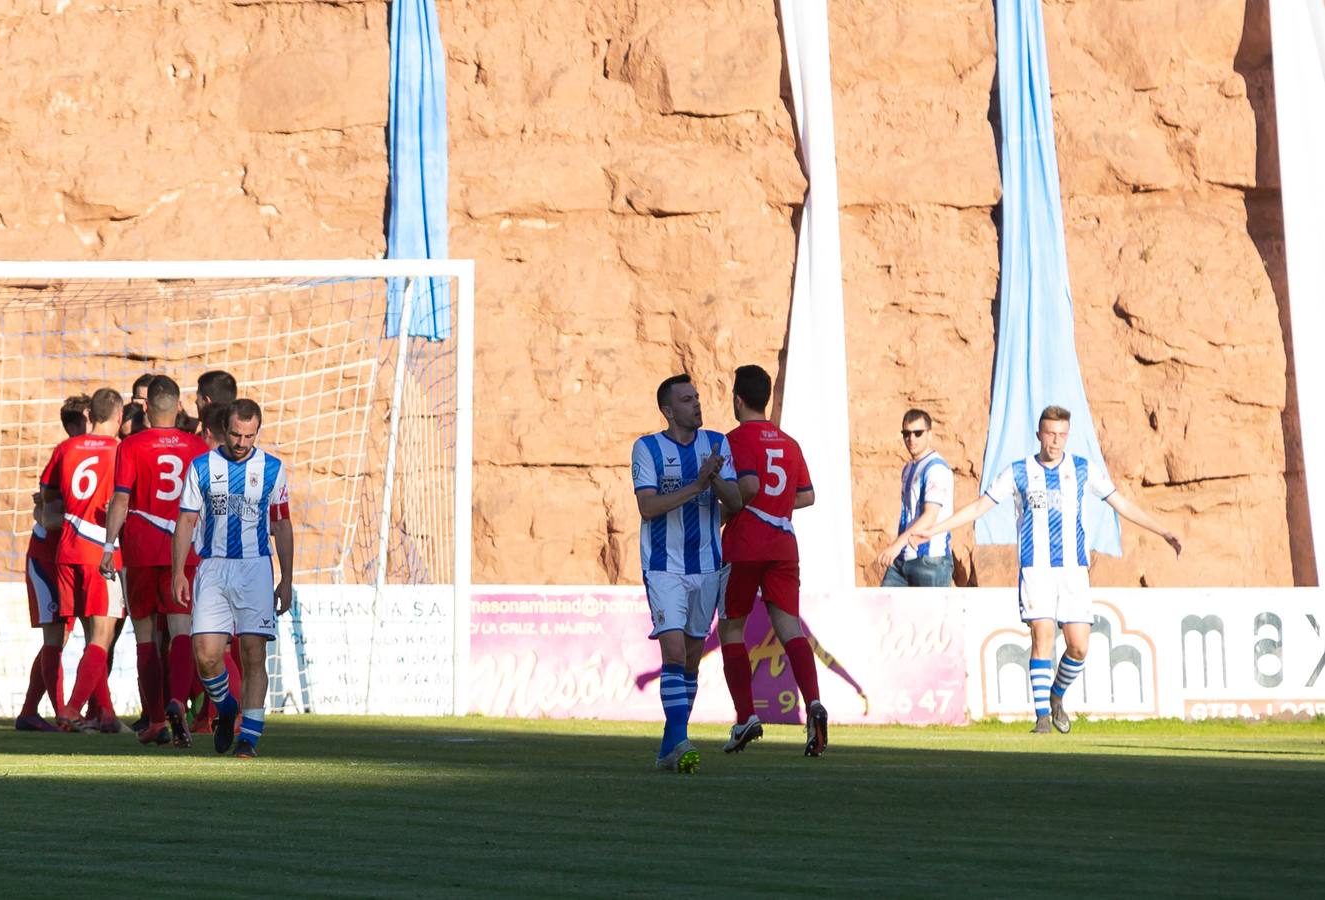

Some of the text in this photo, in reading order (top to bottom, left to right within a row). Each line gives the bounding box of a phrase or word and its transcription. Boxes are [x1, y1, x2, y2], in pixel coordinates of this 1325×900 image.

[71, 456, 99, 500] 6
[156, 454, 184, 501] 3
[764, 448, 788, 496] 5
[470, 592, 651, 617] mesonamistad@hotma
[917, 688, 955, 714] 47
